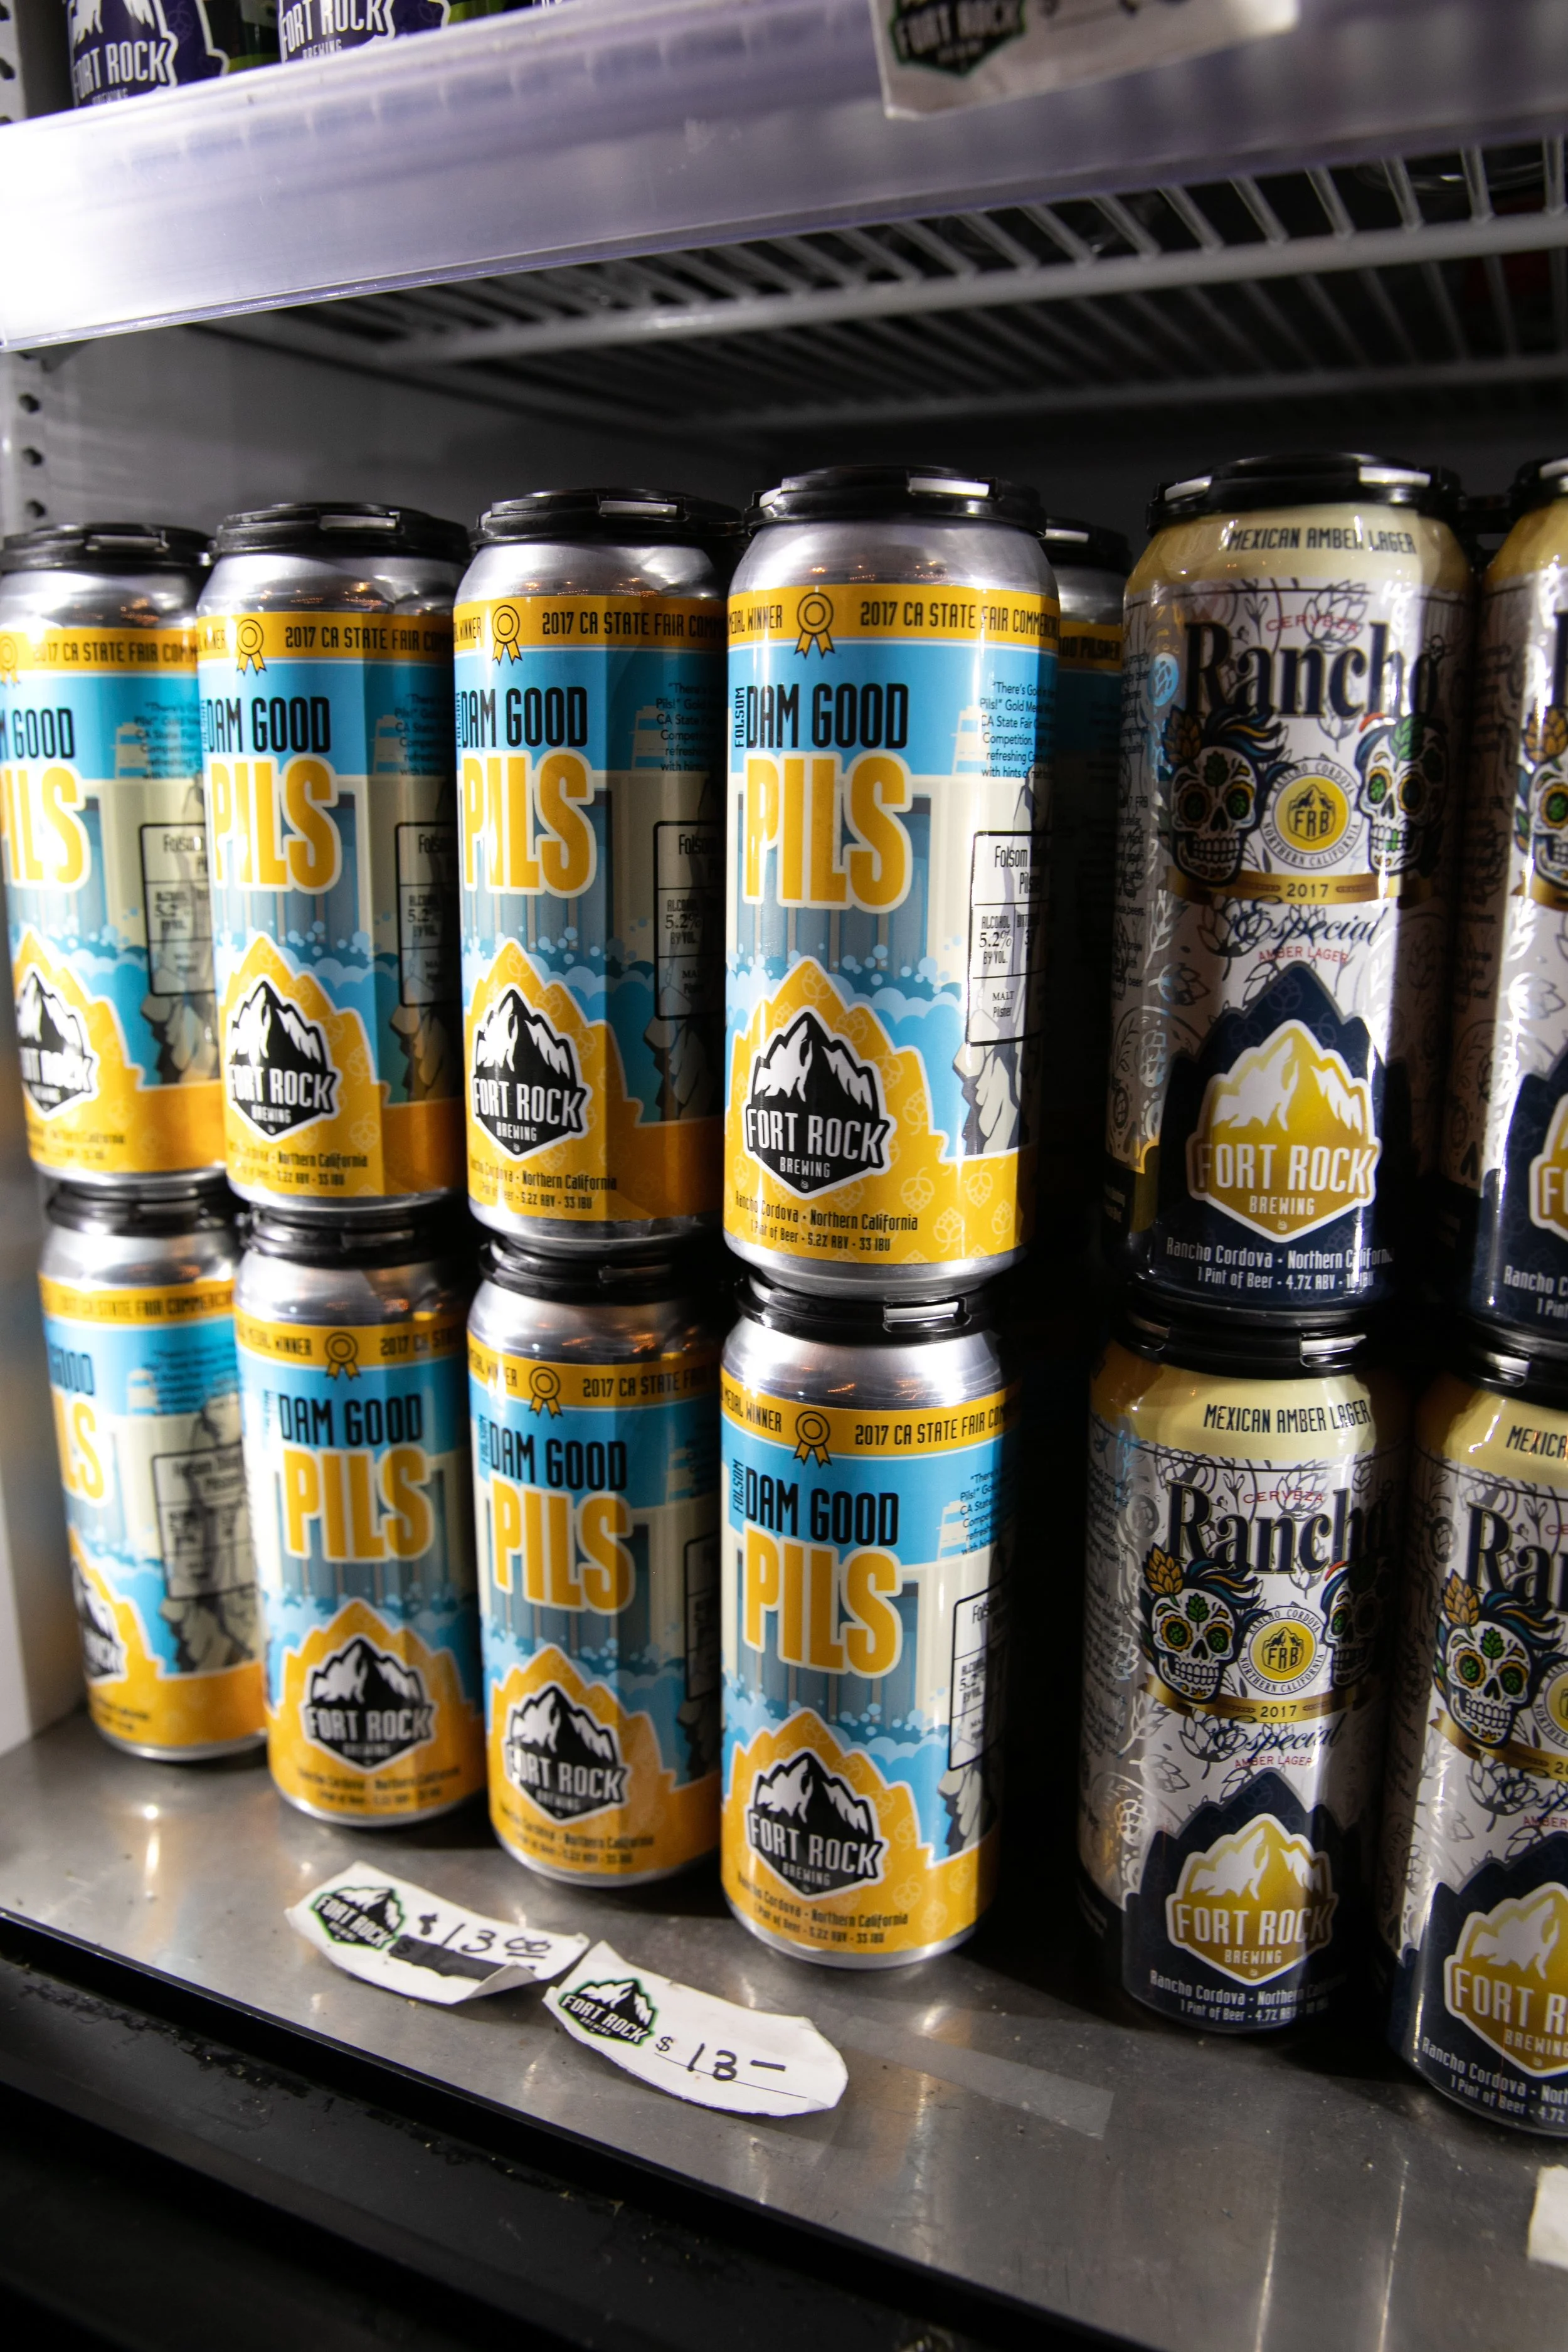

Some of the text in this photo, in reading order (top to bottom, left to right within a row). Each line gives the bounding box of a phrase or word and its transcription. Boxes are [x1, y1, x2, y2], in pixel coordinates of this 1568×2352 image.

[106, 40, 167, 83] ROCK
[1227, 527, 1416, 554] MEXICAN AMBER LAGER
[543, 612, 684, 636] 2017 CA STATE FAIR
[861, 602, 1009, 630] 2017 CA STATE FAIR
[64, 641, 79, 662] CA
[83, 641, 125, 663] STATE
[285, 627, 420, 651] 2017 CA STATE FAIR
[1184, 621, 1438, 719] Rancho
[208, 698, 243, 752] DAM
[252, 696, 331, 753] GOOD
[462, 687, 588, 748] DAM GOOD
[734, 687, 745, 748] FOLSOM
[746, 683, 909, 749] DAM GOOD
[997, 716, 1017, 728] State
[13, 708, 76, 759] GOOD
[209, 756, 340, 892] PILS
[462, 750, 593, 895] PILS
[744, 752, 909, 909] PILS
[1295, 810, 1330, 837] FRB
[995, 846, 1027, 867] Folsom
[1263, 822, 1360, 867] NORTHERN CALIFORNIA
[1286, 884, 1328, 898] 2017
[980, 931, 1011, 948] 5.2%
[1307, 946, 1348, 964] LAGER
[992, 991, 1014, 1001] MALT
[270, 1068, 331, 1110] ROCK
[473, 1076, 581, 1128] FORT ROCK
[497, 1125, 538, 1142] BREWING
[748, 1109, 887, 1163] FORT ROCK
[522, 1171, 617, 1192] Northern California
[780, 1157, 830, 1179] BREWING
[1198, 1143, 1374, 1194] FORT ROCK
[761, 1201, 918, 1232] Cordova Northern California
[1249, 1196, 1315, 1216] BREWING
[780, 1227, 891, 1251] Beer 5.2% ABV 33 IBU
[1167, 1236, 1342, 1269] Rancho Cordova Northern
[1204, 1266, 1335, 1290] Pint of Beer 4.7% ABV
[1504, 1263, 1554, 1296] Rancho
[380, 1335, 409, 1356] 2017
[583, 1372, 680, 1397] 2017 CA STATE
[278, 1394, 333, 1446] DAM
[344, 1394, 423, 1446] GOOD
[746, 1401, 782, 1433] WINNER
[856, 1412, 985, 1445] 2017 CA STATE FAIR
[1204, 1399, 1372, 1434] MEXICAN AMBER LAGER
[490, 1421, 626, 1492] DAM GOOD
[283, 1446, 433, 1561] PILS
[746, 1466, 899, 1546] DAM GOOD
[1242, 1488, 1325, 1505] CERVEZA
[491, 1474, 633, 1612] PILS
[744, 1523, 899, 1676] PILS
[1286, 1609, 1322, 1633] CORDOVA
[1240, 1654, 1325, 1693] NORTHERN CALIFORNIA
[1268, 1647, 1298, 1669] FRB
[366, 1708, 430, 1741] ROCK
[1259, 1705, 1297, 1718] 2017
[1278, 1756, 1311, 1767] LAGER
[558, 1761, 623, 1801] ROCK
[750, 1813, 881, 1877] FORT ROCK
[782, 1863, 831, 1887] BREWING
[317, 1895, 392, 1949] FORT ROCK
[1177, 1903, 1249, 1945] FORT
[1225, 1948, 1282, 1964] BREWING
[1150, 1968, 1305, 2006] Rancho Cordova Northern
[1455, 1968, 1534, 2027] FORT
[561, 1994, 650, 2043] FORT ROCK
[1187, 2000, 1245, 2022] Pint of Beer
[655, 2036, 674, 2053] $
[1422, 2036, 1527, 2097] Rancho Cordova
[1458, 2078, 1526, 2115] Pint of Beer
